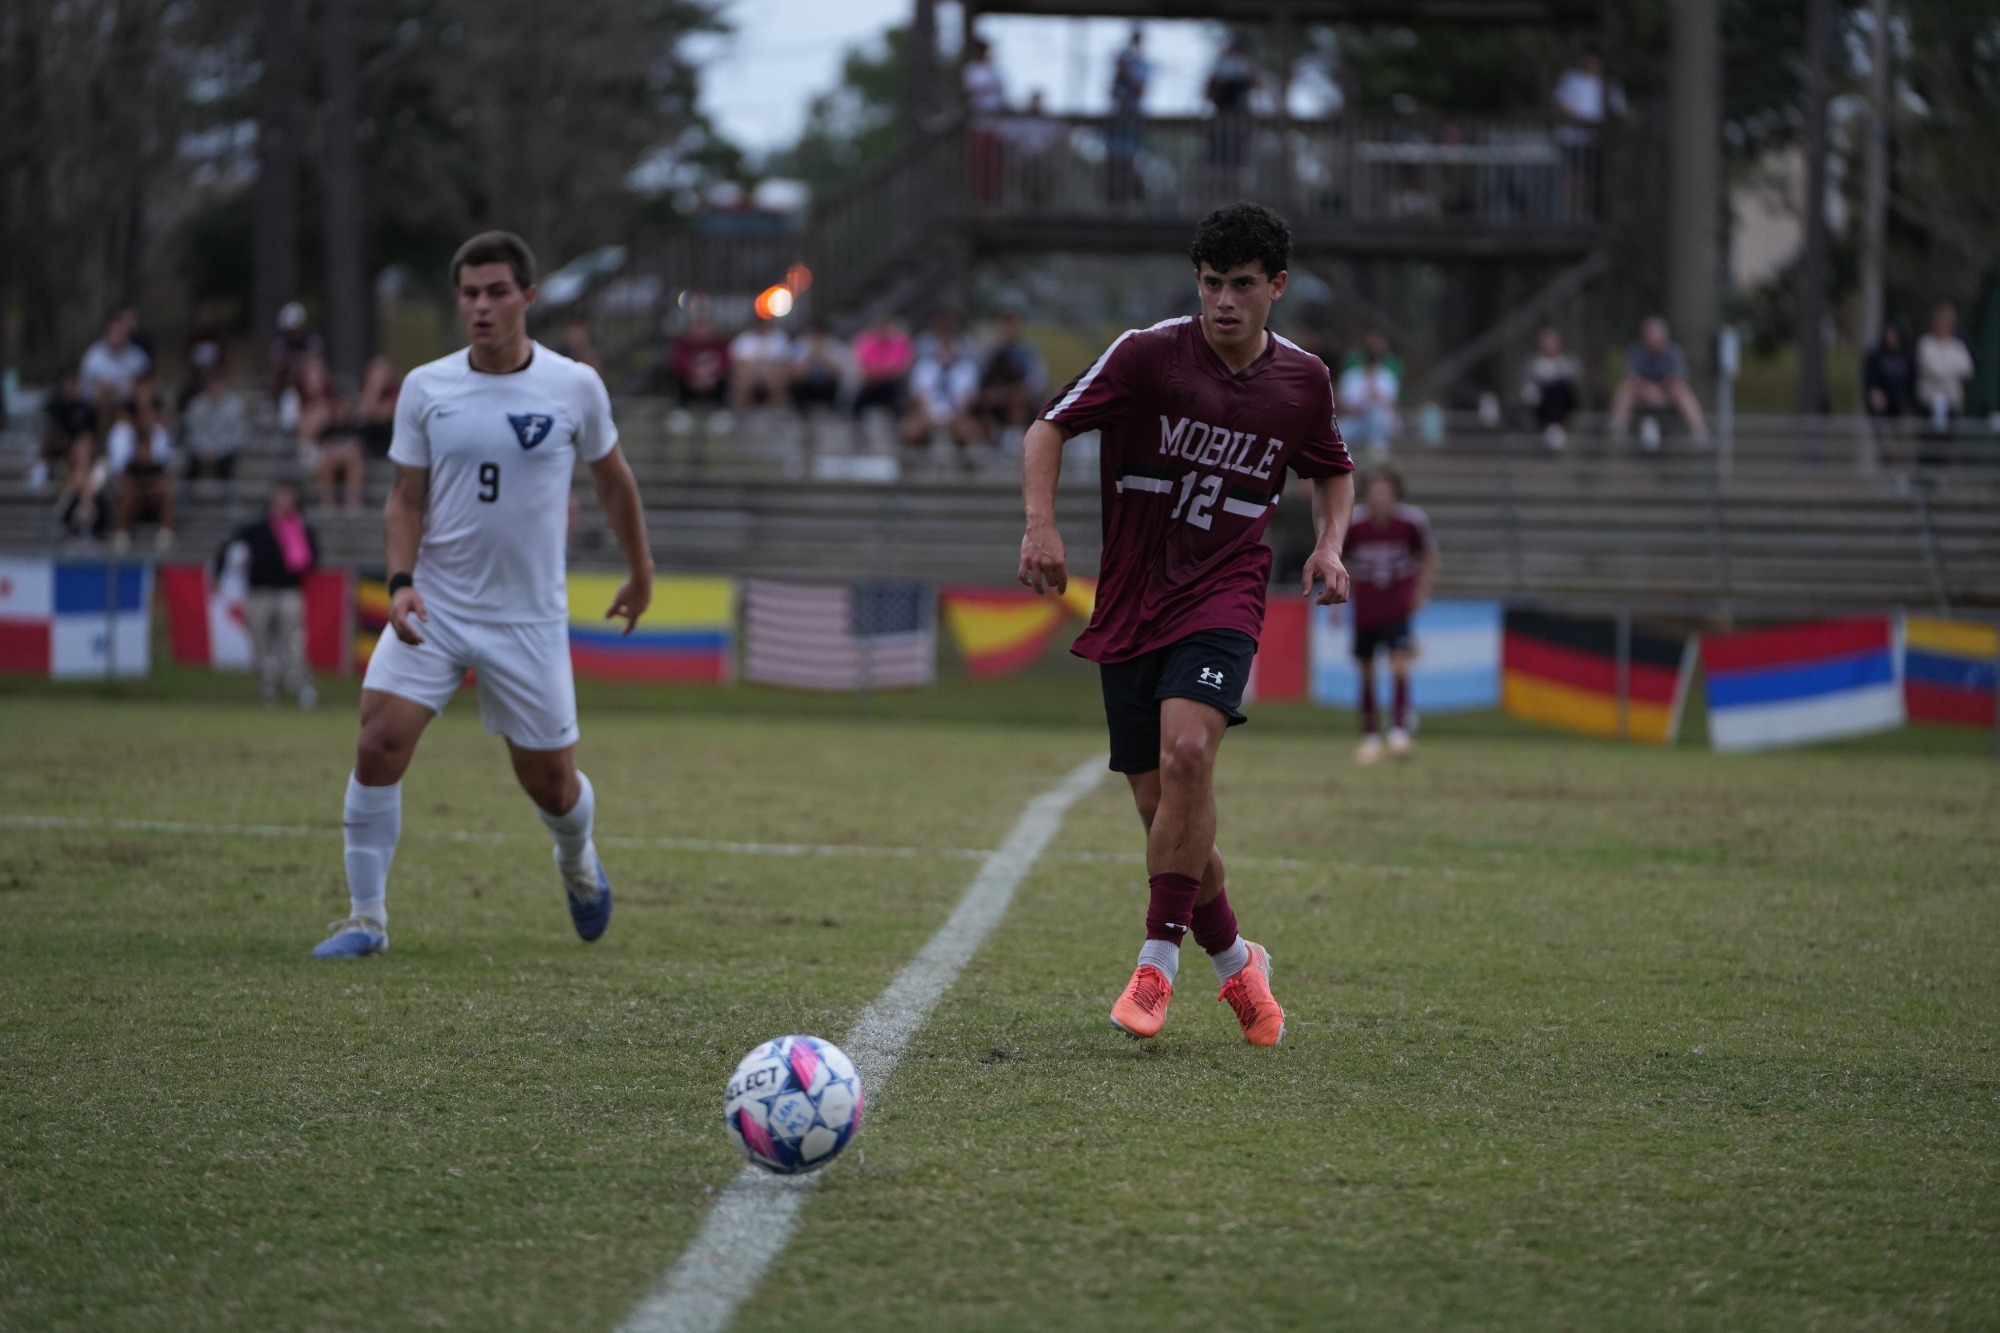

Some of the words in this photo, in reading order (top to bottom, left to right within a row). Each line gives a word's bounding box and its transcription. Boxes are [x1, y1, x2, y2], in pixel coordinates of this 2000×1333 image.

[1159, 415, 1284, 480] MOBILE
[479, 462, 500, 503] 9
[1171, 470, 1223, 531] 12
